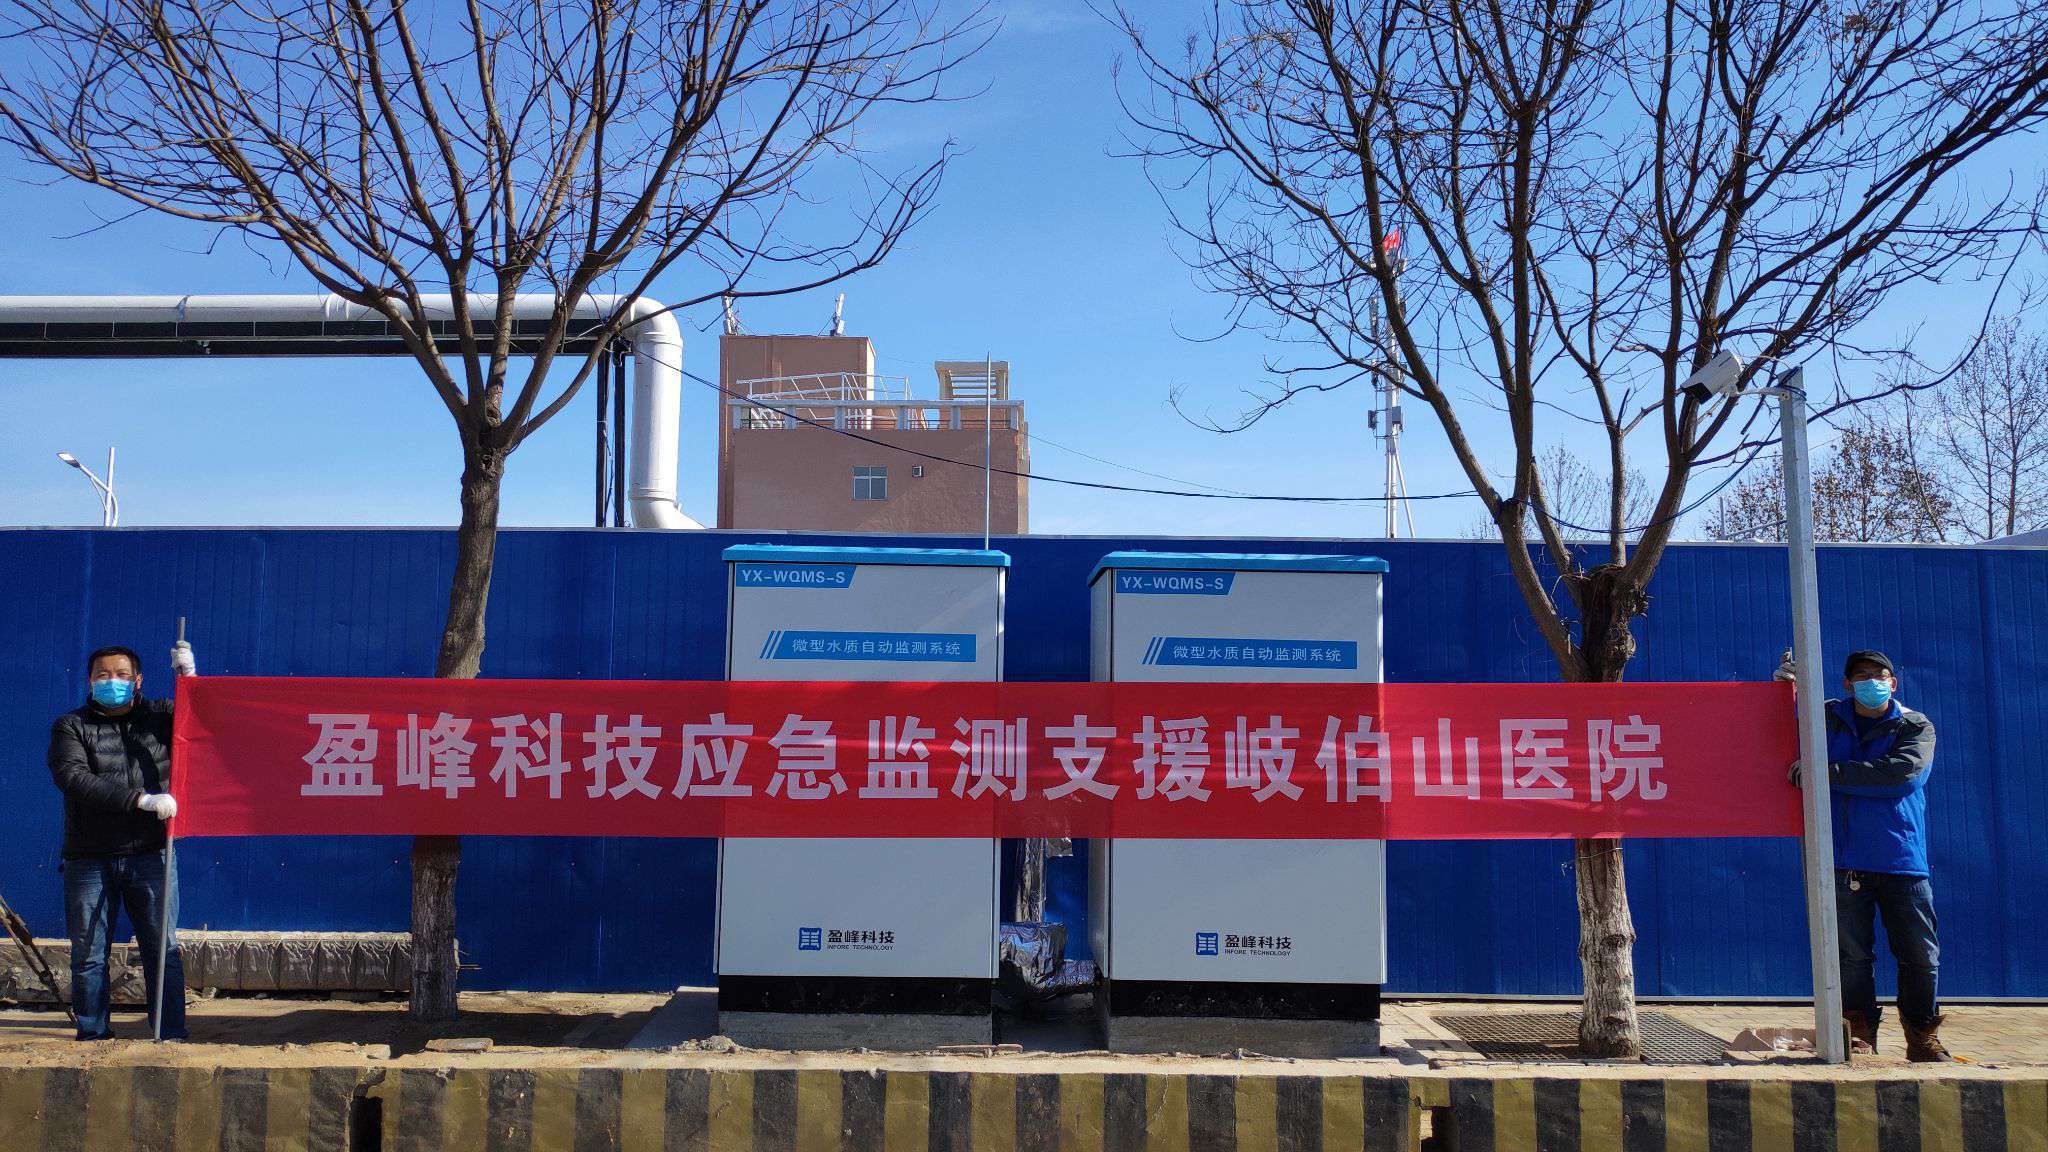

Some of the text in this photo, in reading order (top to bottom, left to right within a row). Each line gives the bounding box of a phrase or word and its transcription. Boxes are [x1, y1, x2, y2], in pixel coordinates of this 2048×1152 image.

[742, 570, 846, 584] YX-WQMS-S
[1122, 577, 1224, 591] YX-WQMS-S
[791, 638, 961, 656] 微型水质自动监测系统
[1173, 645, 1342, 663] 微型水质自动监测系统
[300, 713, 1668, 803] 盈峰科技应急监测支援岐伯山医院
[828, 929, 895, 944] 盈峰科技
[1225, 934, 1292, 949] 盈峰科技
